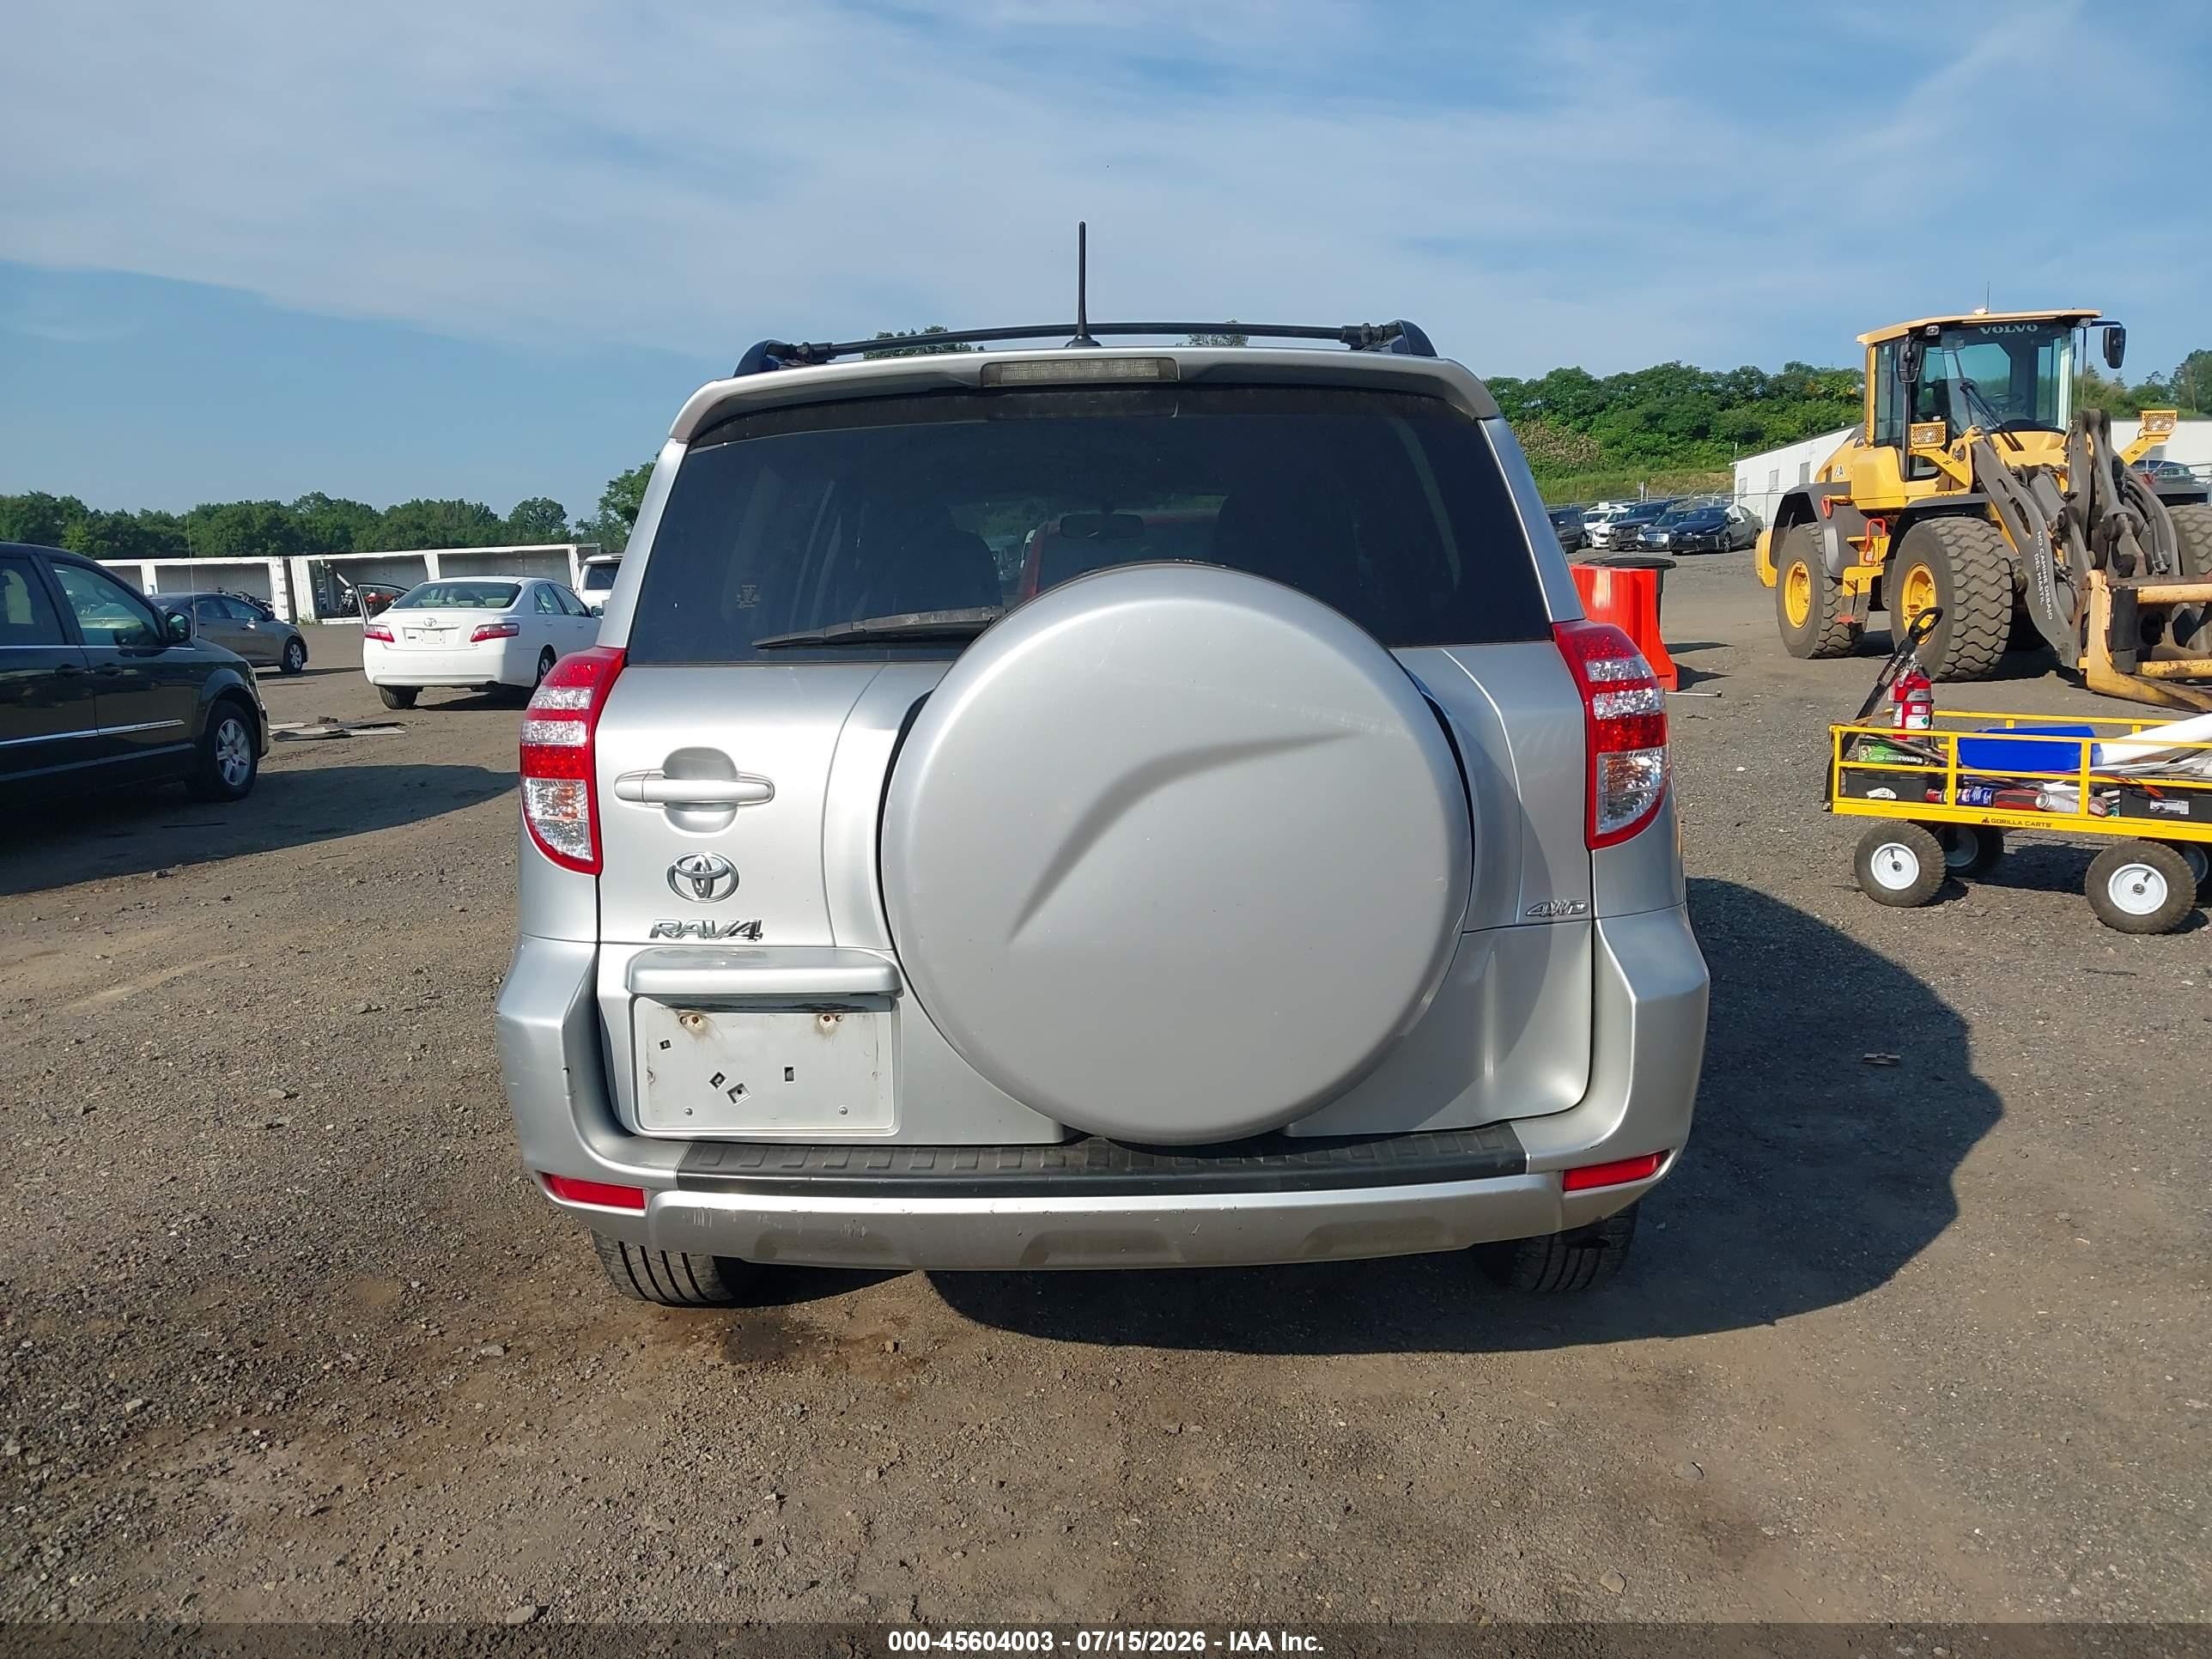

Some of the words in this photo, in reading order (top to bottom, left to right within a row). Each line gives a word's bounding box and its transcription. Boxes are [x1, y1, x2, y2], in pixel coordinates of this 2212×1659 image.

[1979, 324, 2039, 335] VOLVO
[2037, 530, 2044, 546] NO
[2039, 548, 2049, 586] CAMINE
[2044, 586, 2053, 620] DEBAJO
[1990, 817, 2024, 826] GORILLA
[2025, 820, 2052, 829] CARTS
[1525, 899, 1588, 917] 4WD
[648, 919, 763, 942] RAV4
